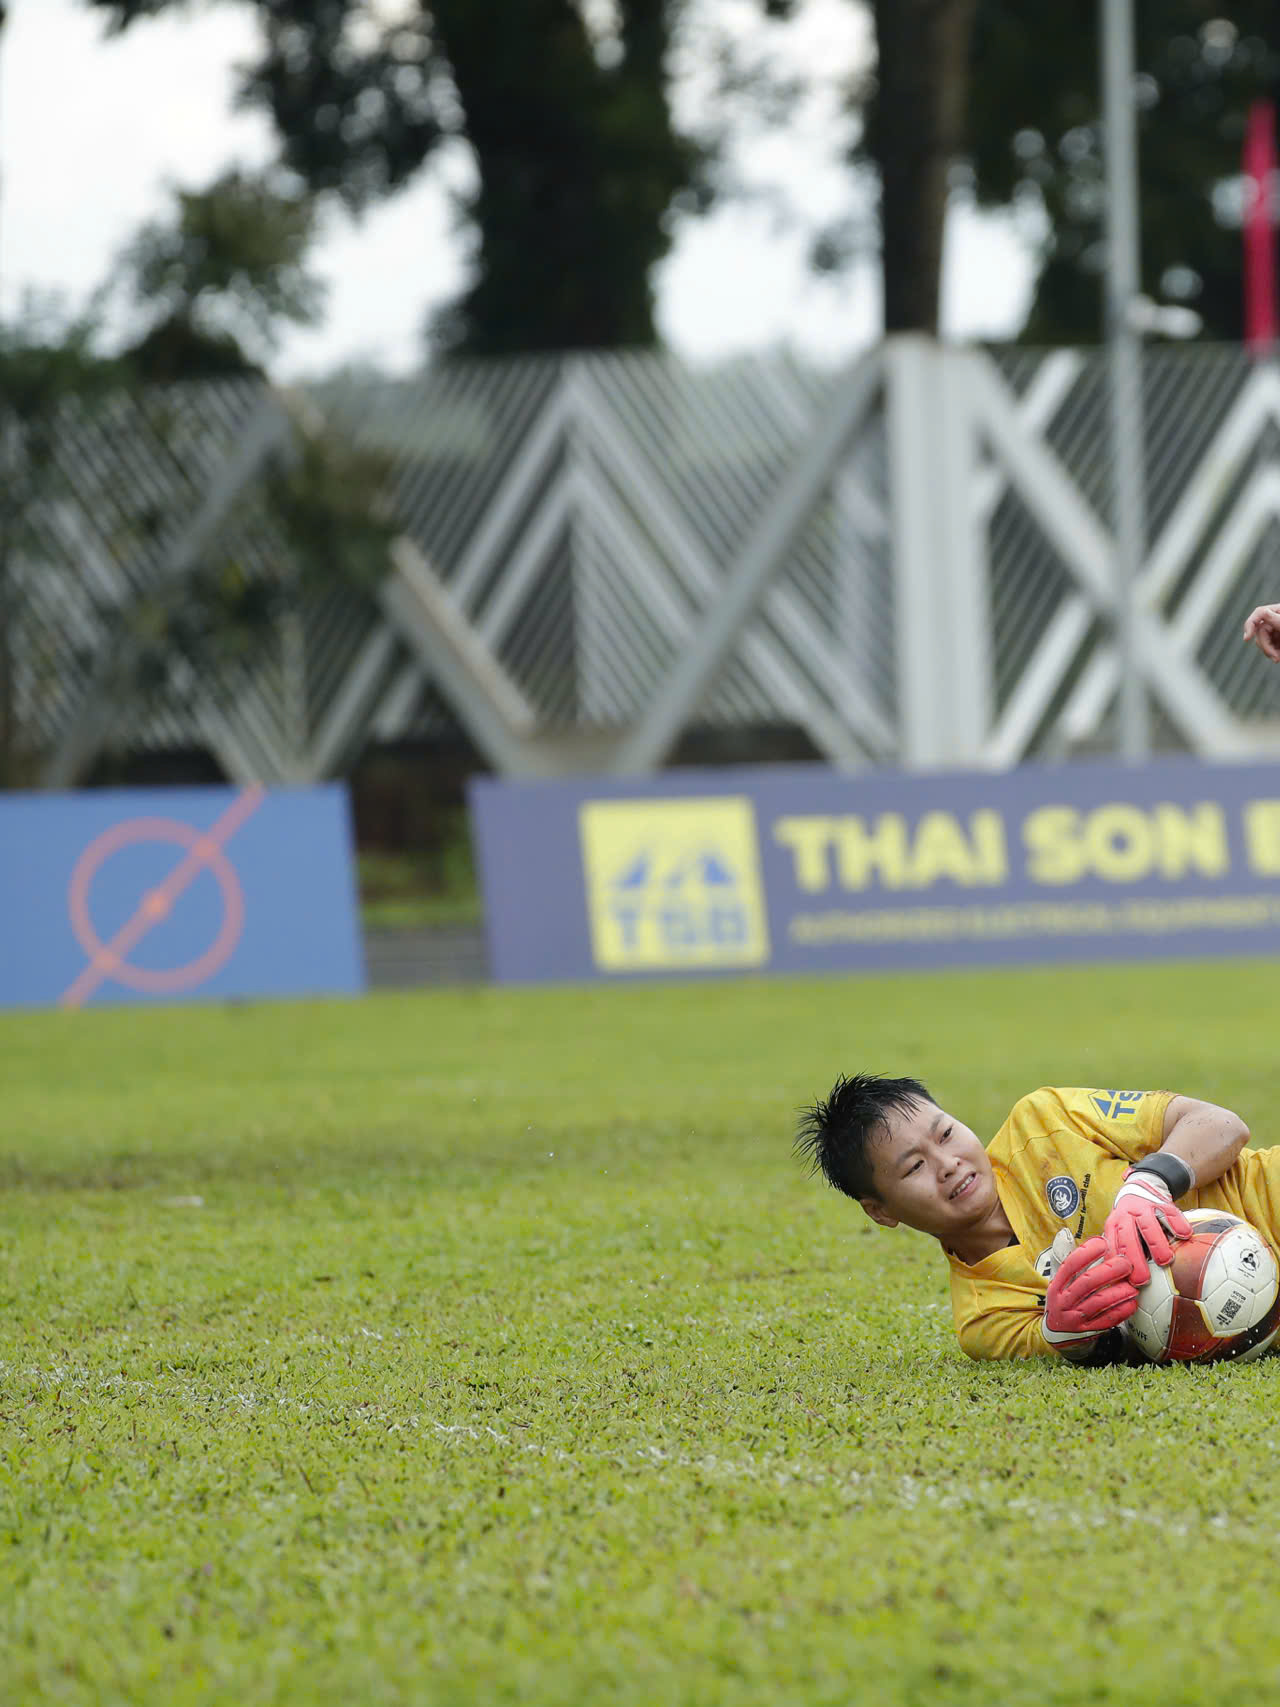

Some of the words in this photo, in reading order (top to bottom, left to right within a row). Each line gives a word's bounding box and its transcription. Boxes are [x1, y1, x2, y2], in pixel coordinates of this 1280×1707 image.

[775, 808, 1007, 894] THAI
[1023, 802, 1228, 887] SON
[1083, 1173, 1091, 1188] club
